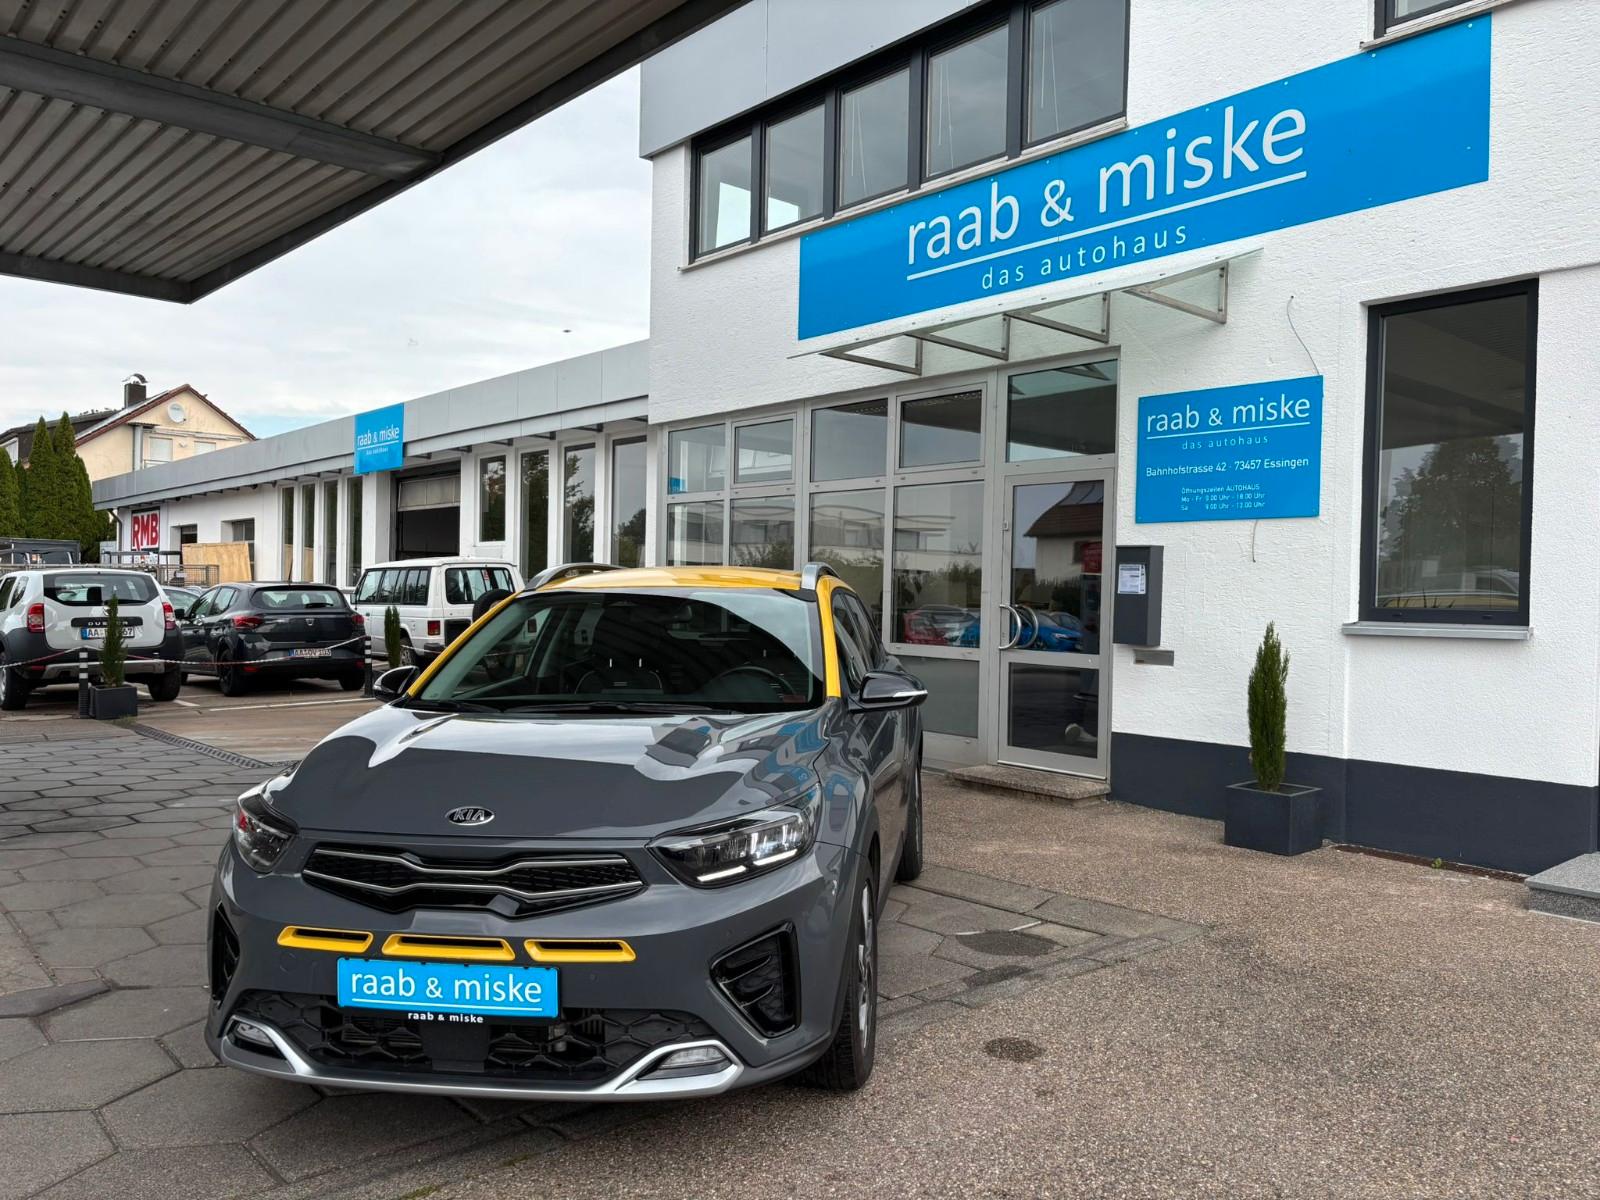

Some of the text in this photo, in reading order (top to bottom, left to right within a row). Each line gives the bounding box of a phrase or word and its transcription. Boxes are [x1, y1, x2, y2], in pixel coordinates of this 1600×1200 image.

[907, 105, 1307, 266] raab & miske
[981, 224, 1187, 290] das autohaus
[1147, 393, 1311, 433] raab & miske
[357, 423, 400, 446] raab & miske
[1182, 435, 1268, 450] das autohaus
[1146, 464, 1214, 477] Bahnhofstrasse
[1215, 462, 1227, 472] 42
[1234, 459, 1262, 471] 73457
[1263, 457, 1309, 470] Essingen
[132, 512, 159, 551] RMB
[87, 628, 100, 637] AA
[453, 808, 485, 821] KIA
[351, 967, 542, 1003] raab & miske
[407, 1011, 484, 1024] raab & miske
